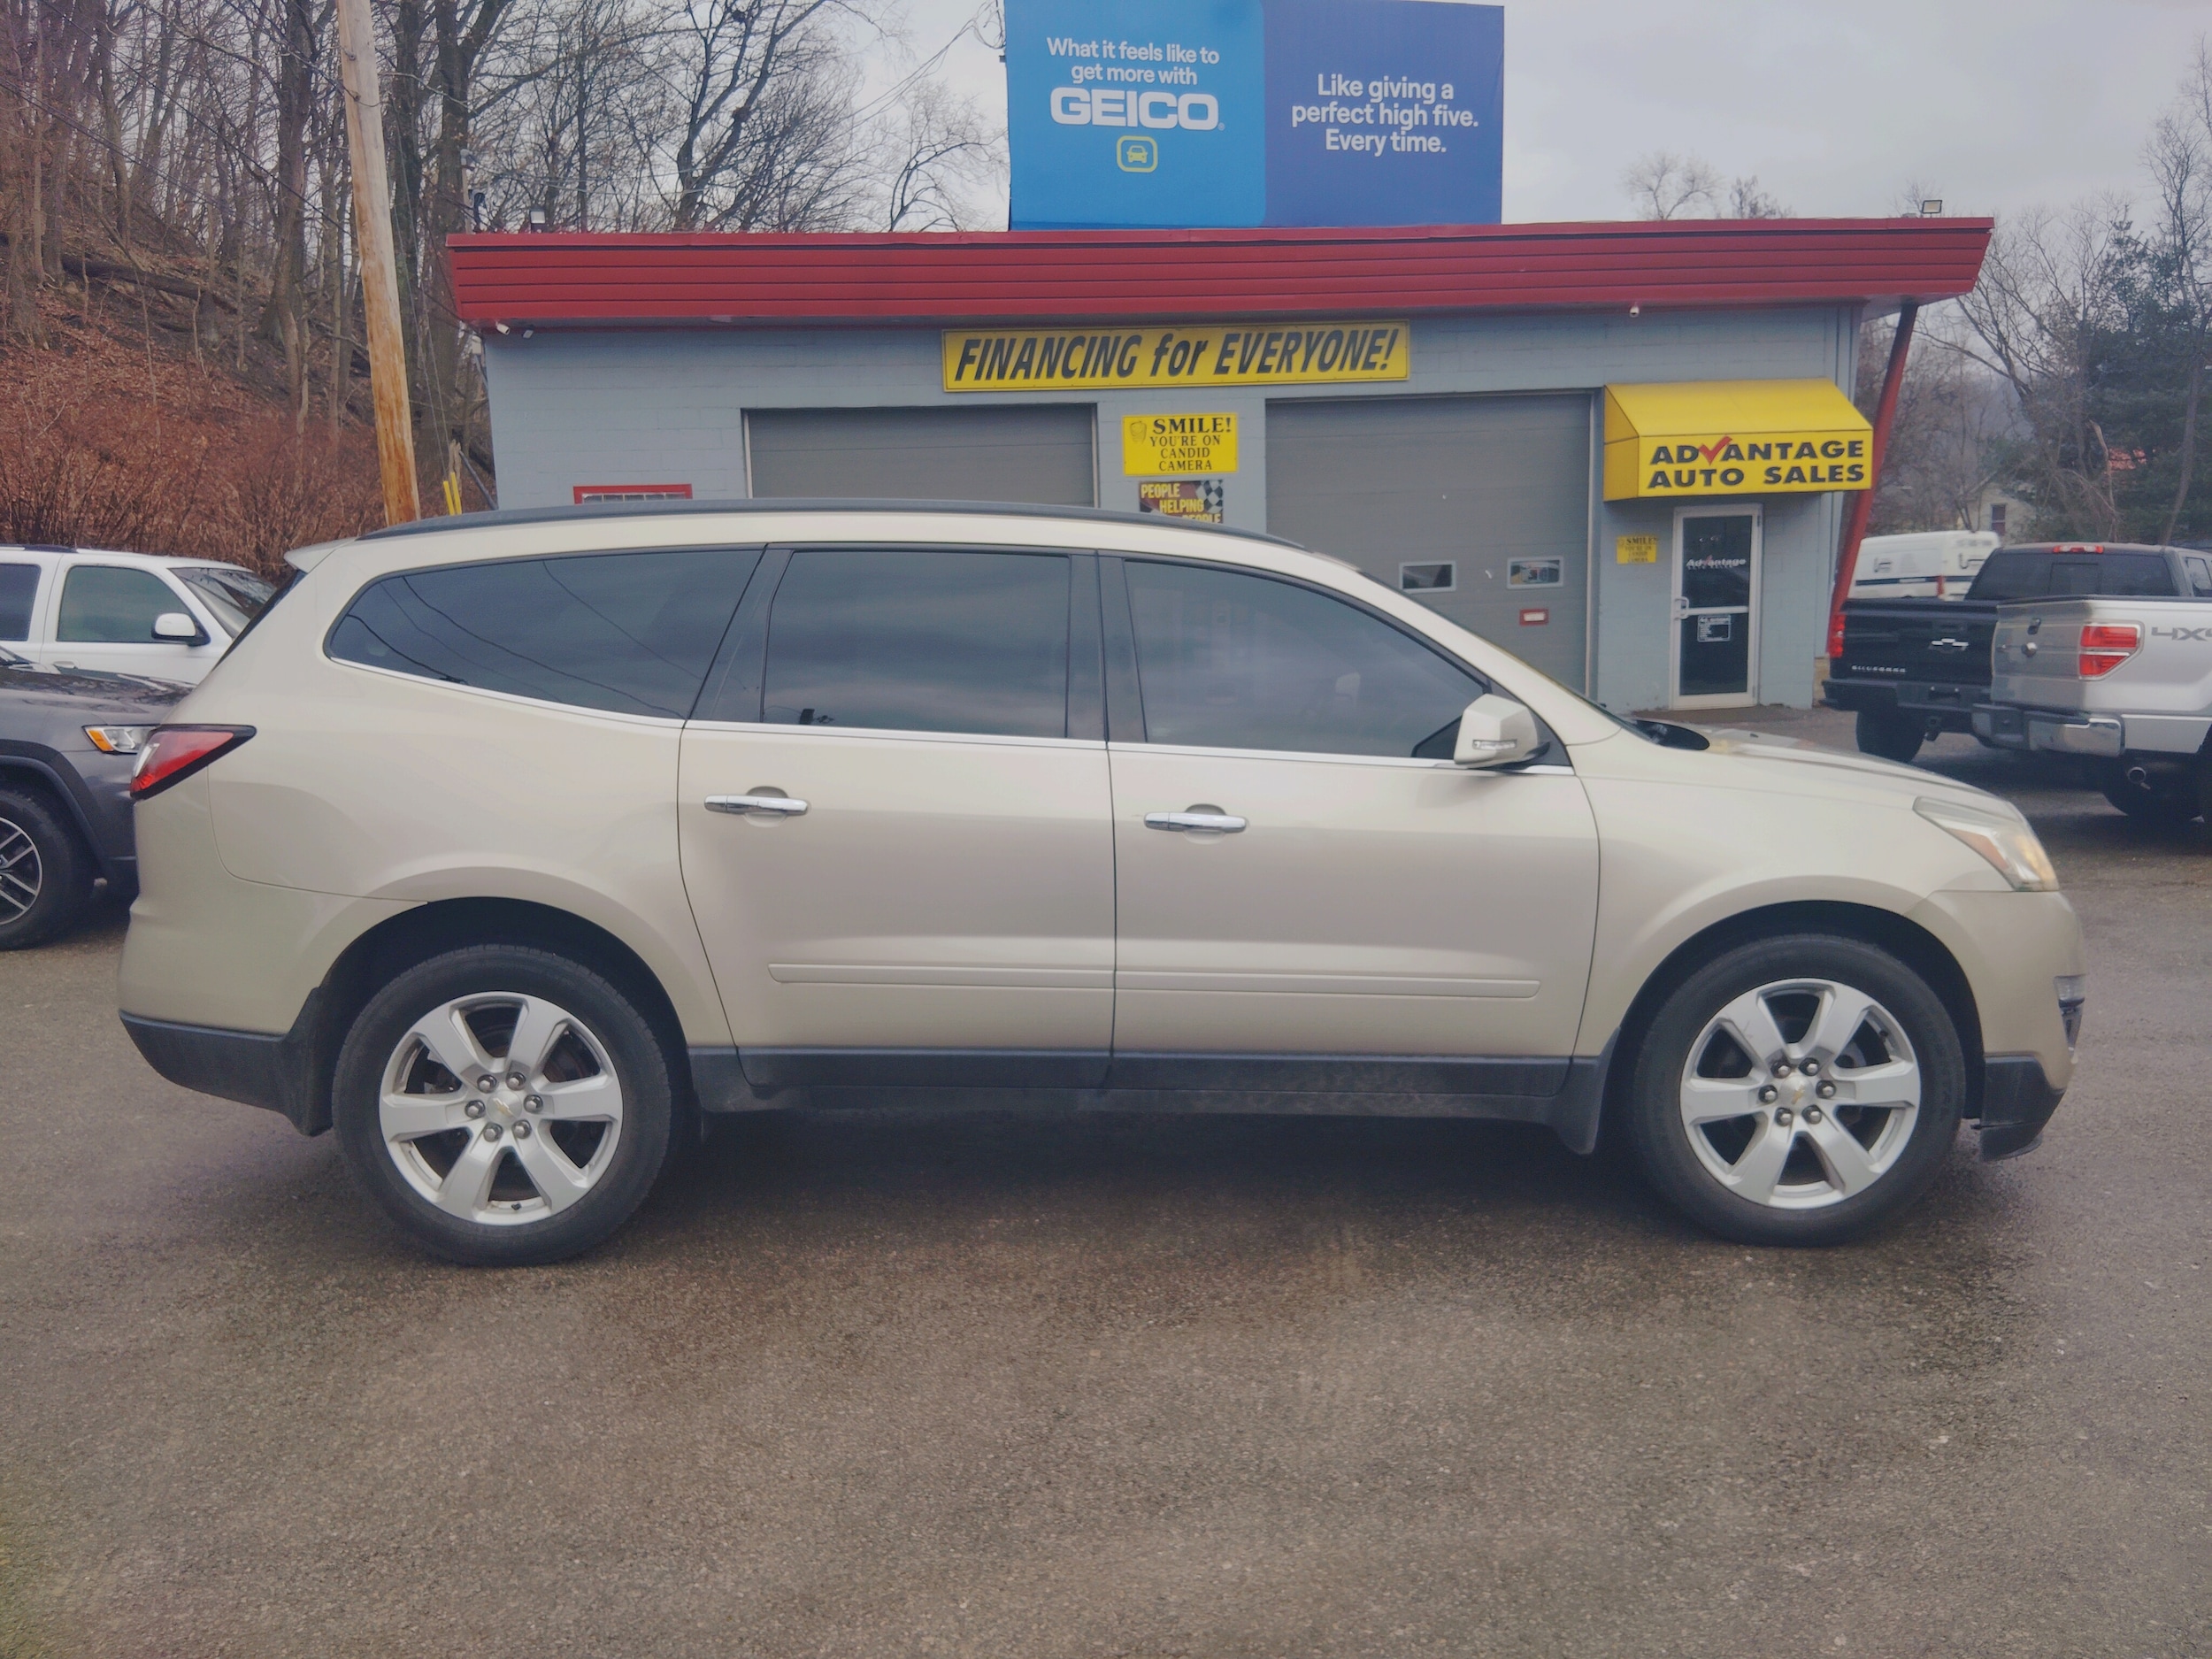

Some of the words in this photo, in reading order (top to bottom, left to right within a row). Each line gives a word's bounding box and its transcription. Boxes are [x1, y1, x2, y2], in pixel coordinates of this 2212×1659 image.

[1047, 37, 1100, 58] What
[1102, 40, 1116, 59] it
[1118, 42, 1164, 62] feels
[1166, 44, 1197, 63] like
[1200, 47, 1220, 65] to
[1071, 63, 1103, 84] get
[1107, 66, 1156, 83] more
[1158, 66, 1198, 85] with
[1317, 73, 1363, 96] Like
[1368, 75, 1436, 104] giving
[1440, 82, 1455, 99] a
[1050, 87, 1219, 130] GEICO
[1292, 101, 1375, 127] perfect
[1379, 103, 1428, 131] high
[1432, 104, 1479, 127] five.
[1325, 128, 1386, 157] Every
[1390, 131, 1447, 152] time.
[955, 334, 1143, 381] FINANCING
[1149, 333, 1210, 378] for
[1213, 328, 1400, 375] EVERYONE!
[1152, 417, 1232, 434] SMILE!
[1149, 435, 1197, 447] YOU'RE
[1202, 434, 1221, 445] ON
[1650, 436, 1864, 466] ADVANTAGE
[1160, 447, 1210, 459] CANDID
[1158, 459, 1213, 472] CAMERA
[1647, 468, 1744, 489] AUTO
[1763, 464, 1864, 485] SALES
[1141, 483, 1180, 498] PEOPLE
[1159, 499, 1204, 513] HELPING
[2151, 626, 2212, 641] 4X
